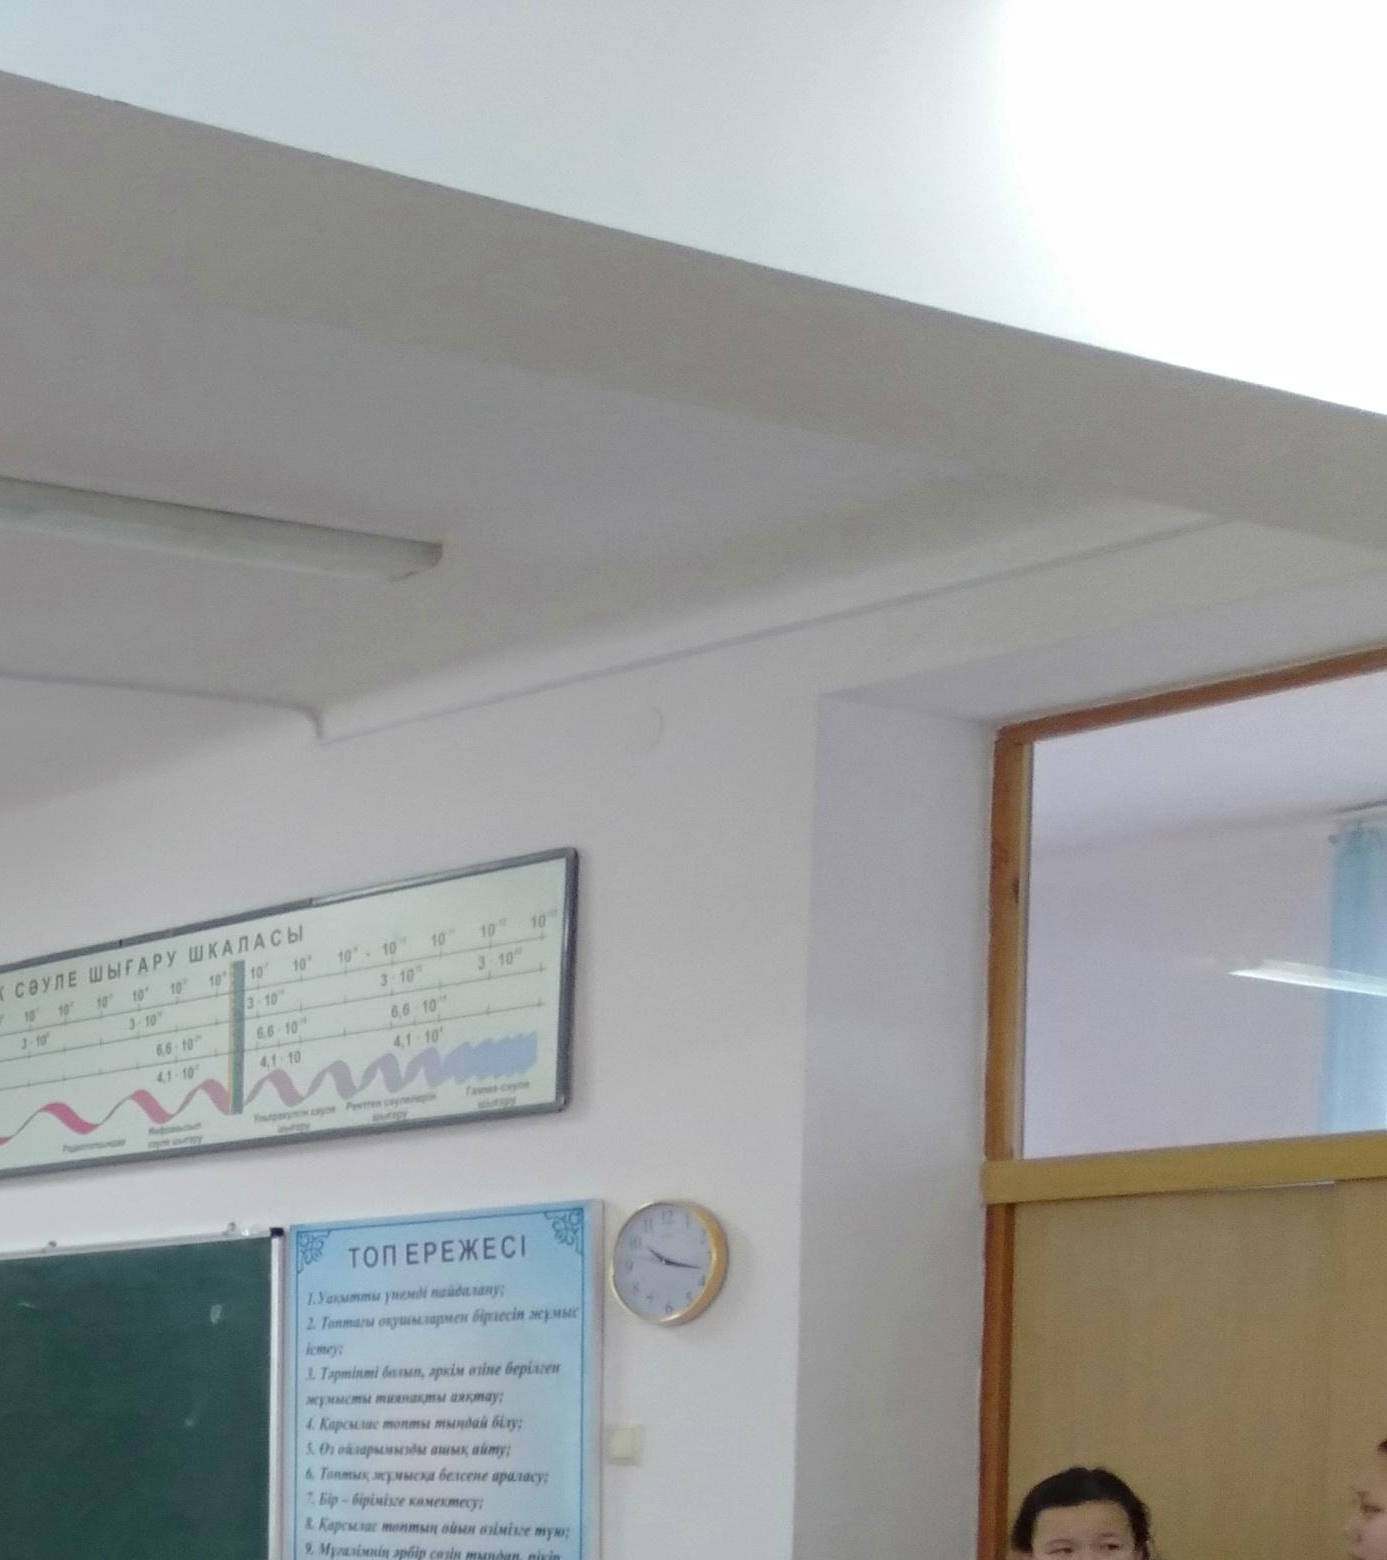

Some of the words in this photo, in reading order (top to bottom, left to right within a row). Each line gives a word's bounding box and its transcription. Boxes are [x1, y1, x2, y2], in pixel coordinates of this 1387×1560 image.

[15, 971, 78, 999] СӘУЛЕ
[88, 951, 177, 984] ШЫҒАРУ
[189, 925, 304, 963] ШКАЛАСЫ
[347, 1244, 397, 1269] ТОП
[406, 1234, 526, 1266] ЕРЕЖЕСІ
